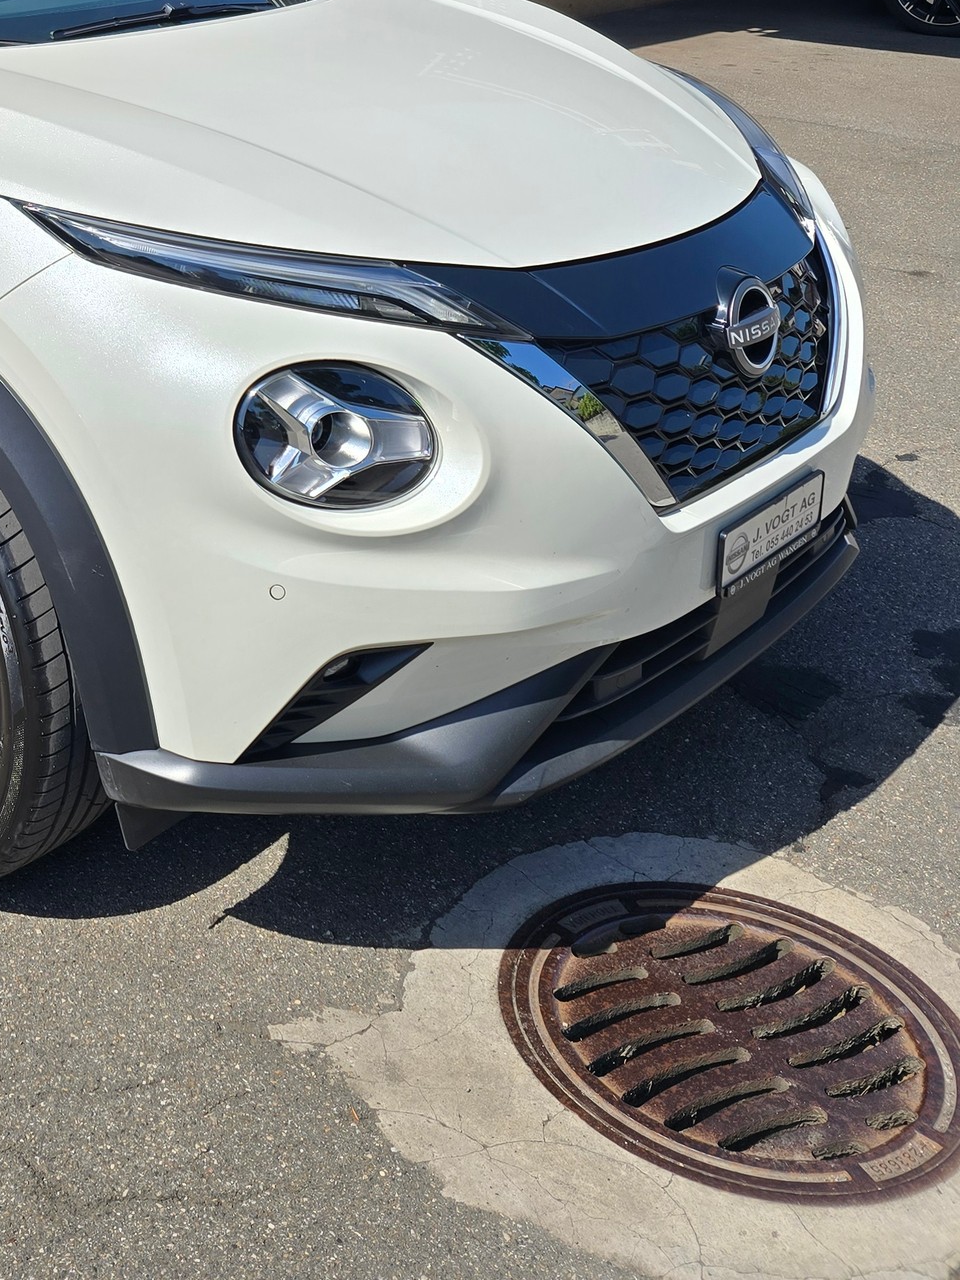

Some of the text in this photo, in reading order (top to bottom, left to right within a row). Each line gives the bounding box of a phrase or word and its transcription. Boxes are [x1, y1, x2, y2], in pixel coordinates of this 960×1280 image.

[751, 511, 814, 562] Tel. 055 440 24 53
[752, 492, 815, 544] J. VOGT AG
[727, 541, 749, 562] NISSAN
[766, 555, 778, 570] AG
[778, 536, 807, 561] WANGEN
